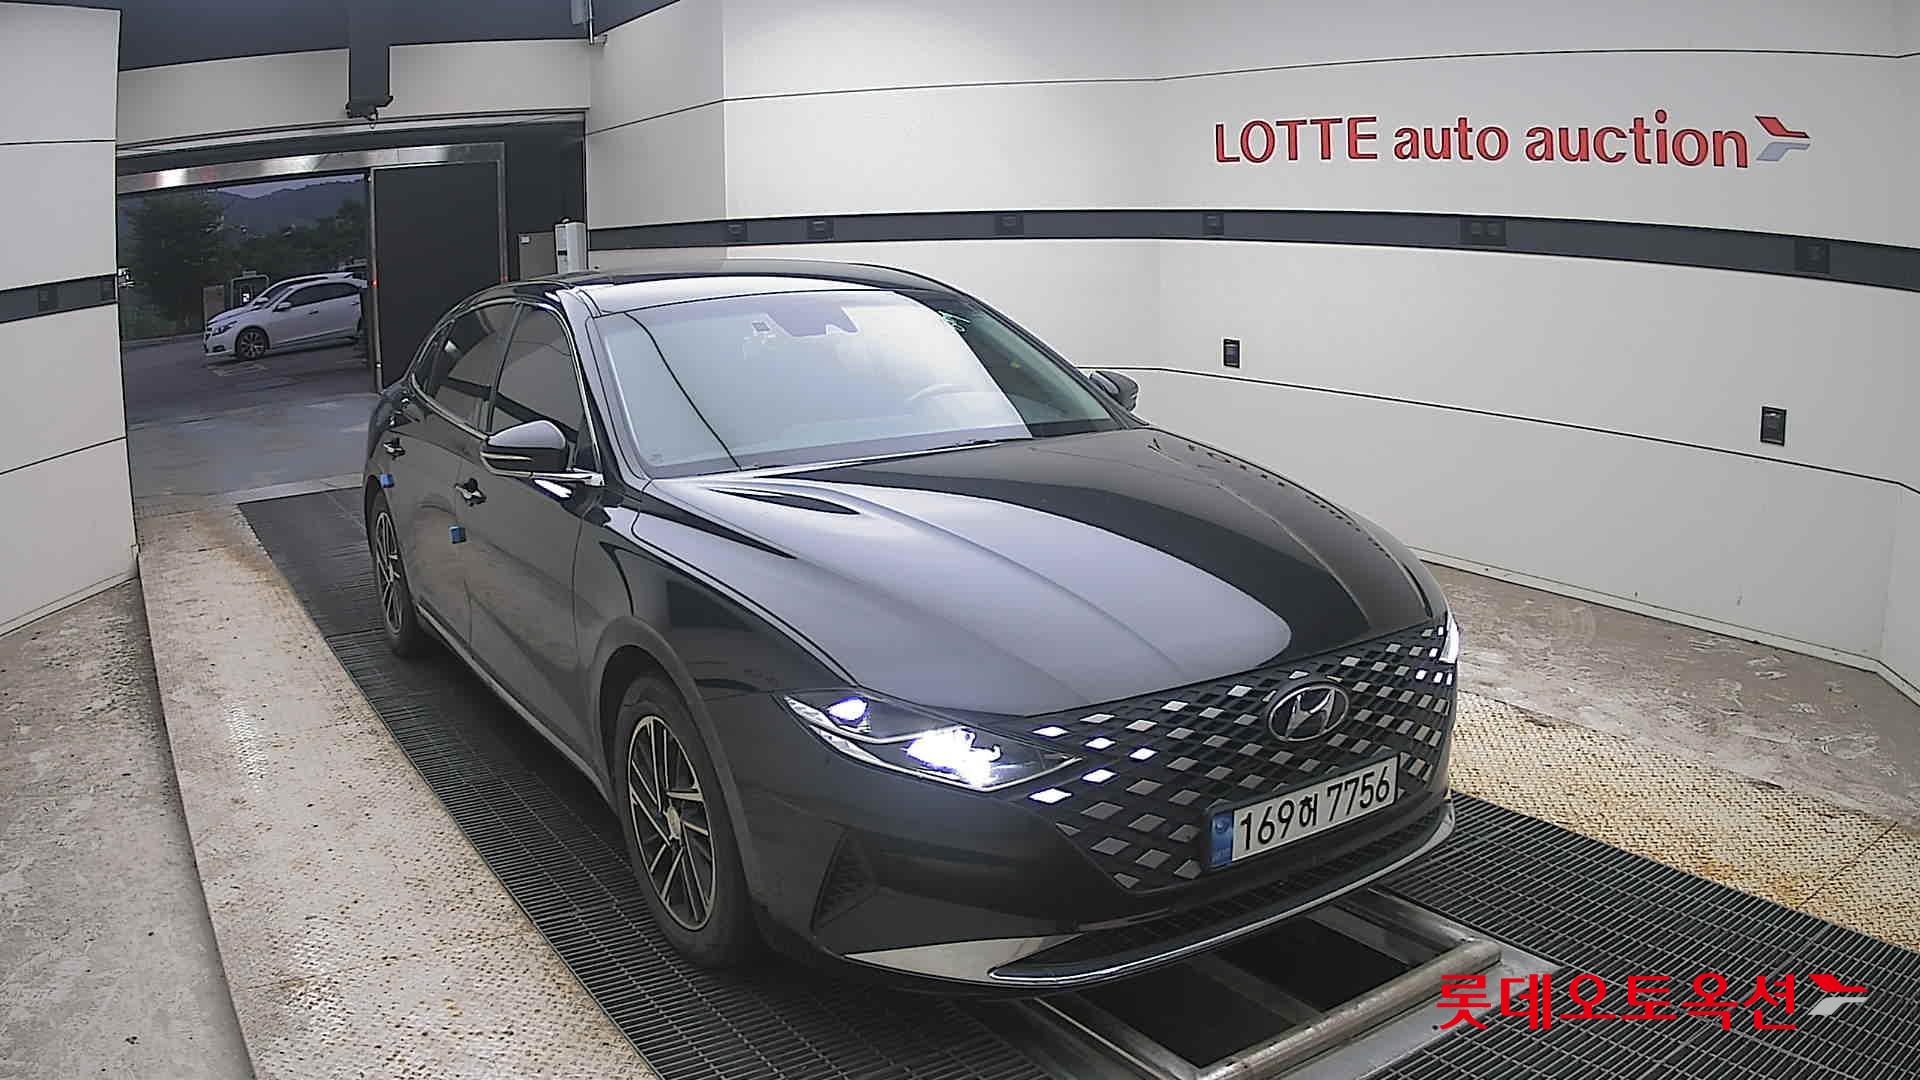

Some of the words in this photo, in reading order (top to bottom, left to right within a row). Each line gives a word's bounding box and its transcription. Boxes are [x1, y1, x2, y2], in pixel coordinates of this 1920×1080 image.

[1215, 116, 1377, 163] LOTTE
[1394, 116, 1511, 161] auto
[1524, 110, 1751, 168] auction
[1240, 793, 1319, 850] 169허
[1327, 766, 1390, 821] 7756
